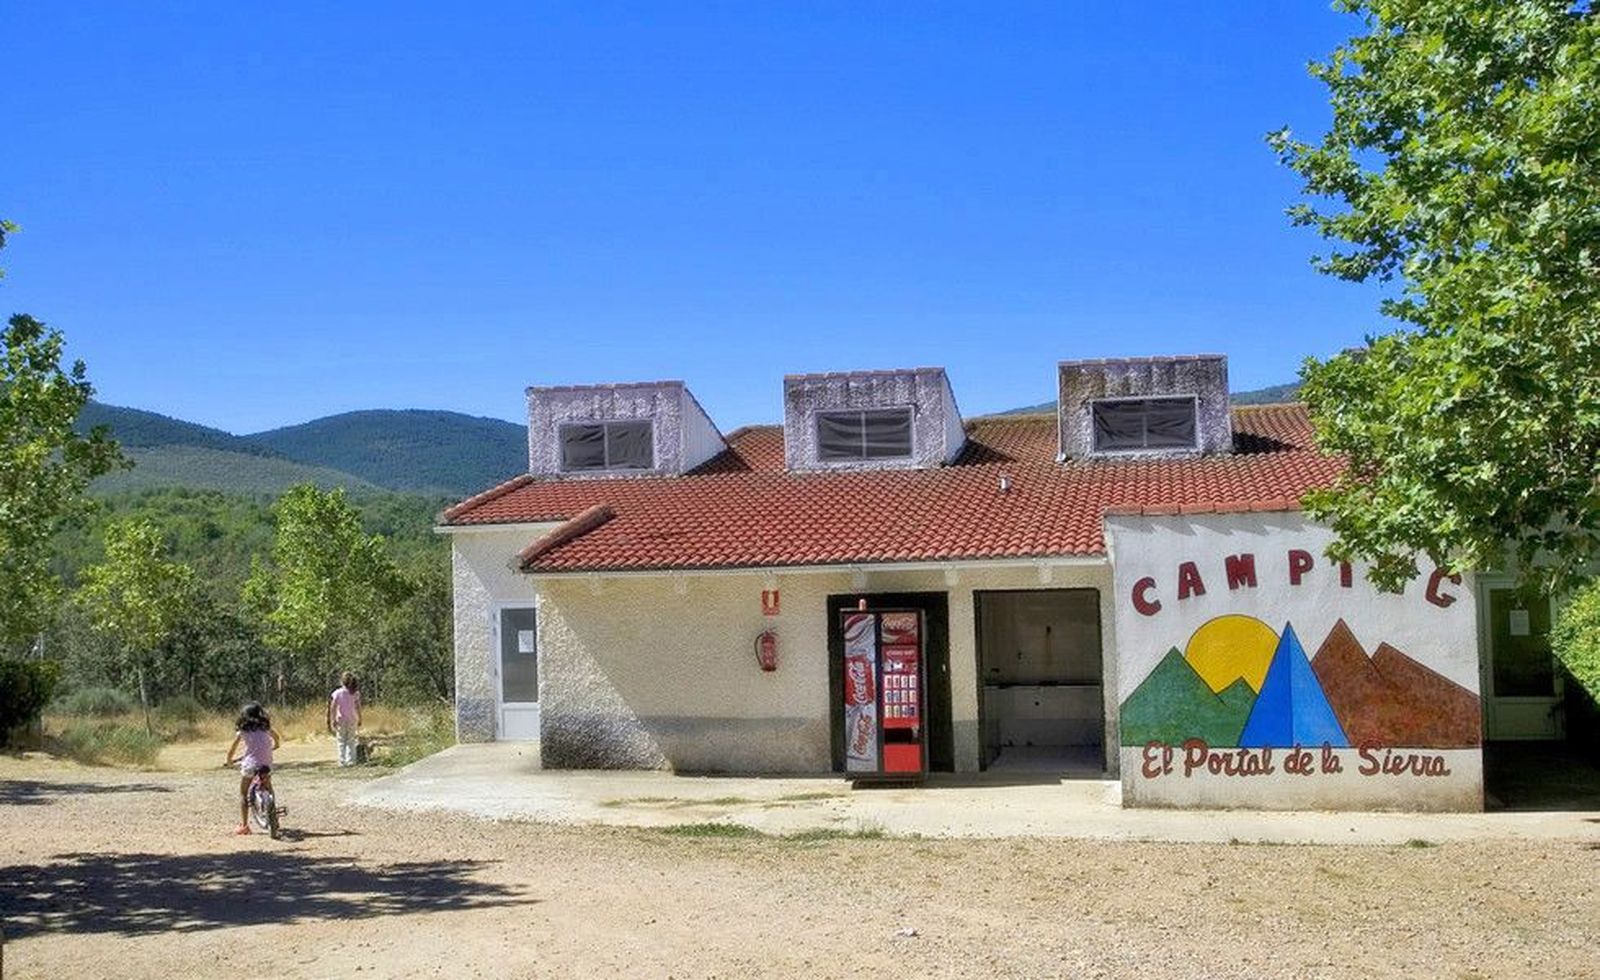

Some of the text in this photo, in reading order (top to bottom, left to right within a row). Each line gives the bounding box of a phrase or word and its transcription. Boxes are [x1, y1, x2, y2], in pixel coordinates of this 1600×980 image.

[1131, 549, 1462, 616] CAMPIG
[1142, 737, 1452, 779] El Portal de la Sierra
